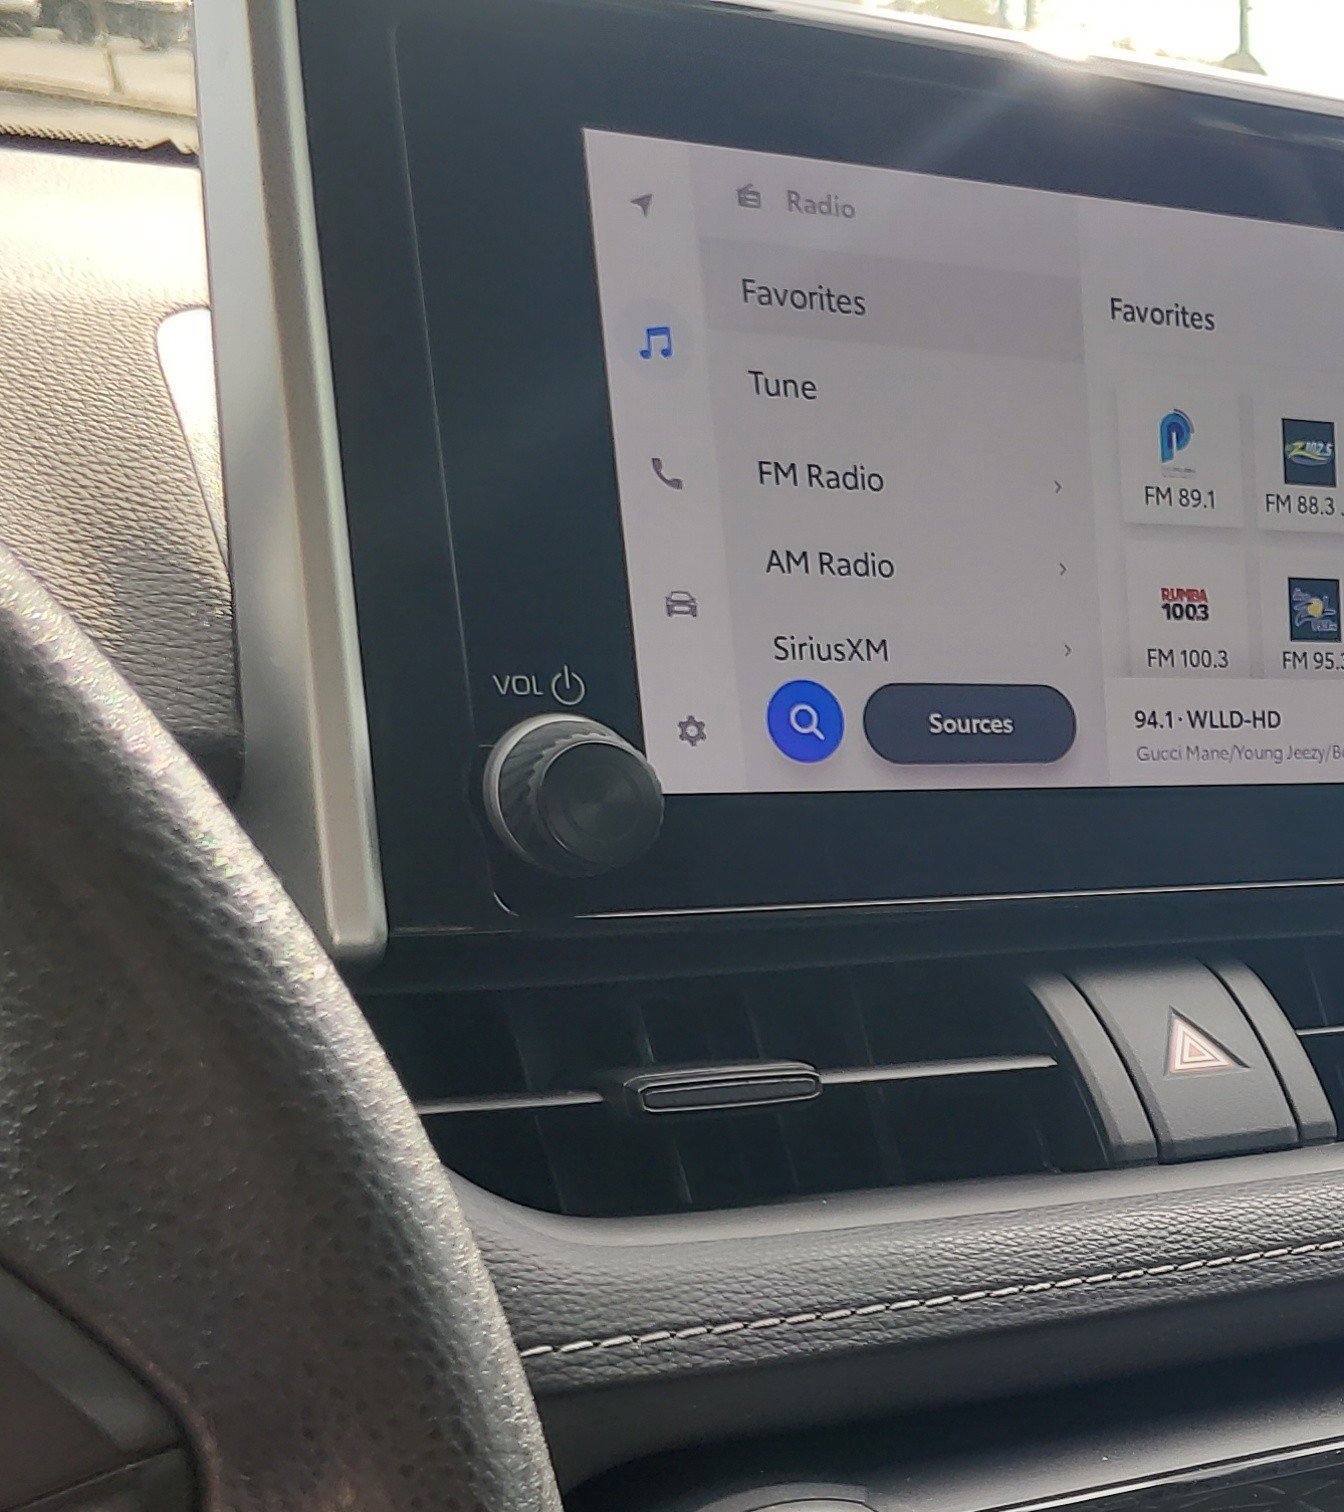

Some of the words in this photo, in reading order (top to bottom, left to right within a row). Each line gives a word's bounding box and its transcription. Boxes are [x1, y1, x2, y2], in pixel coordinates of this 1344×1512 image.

[786, 189, 857, 219] Radio
[742, 278, 867, 316] Favorites
[1110, 297, 1216, 332] Favorites
[748, 370, 818, 400] Tune
[758, 461, 798, 487] FM
[807, 463, 885, 493] Radio
[1144, 486, 1173, 507] FM
[1178, 488, 1216, 510] 89.1
[1265, 493, 1293, 514] FM
[1297, 495, 1336, 516] 88.3
[766, 549, 809, 575] AM
[819, 550, 896, 579] Radio
[1160, 587, 1209, 603] RUMBA
[773, 636, 890, 663] SiriusXM
[1147, 648, 1175, 668] FM
[1180, 649, 1229, 669] 100.3
[1282, 651, 1309, 670] FM
[492, 674, 544, 696] VOL
[928, 712, 1015, 735] Sources
[1134, 710, 1174, 730] 94.1
[1187, 710, 1282, 730] WLLD-HD
[1136, 745, 1183, 763] Gucci
[1186, 744, 1284, 765] Mane/Young
